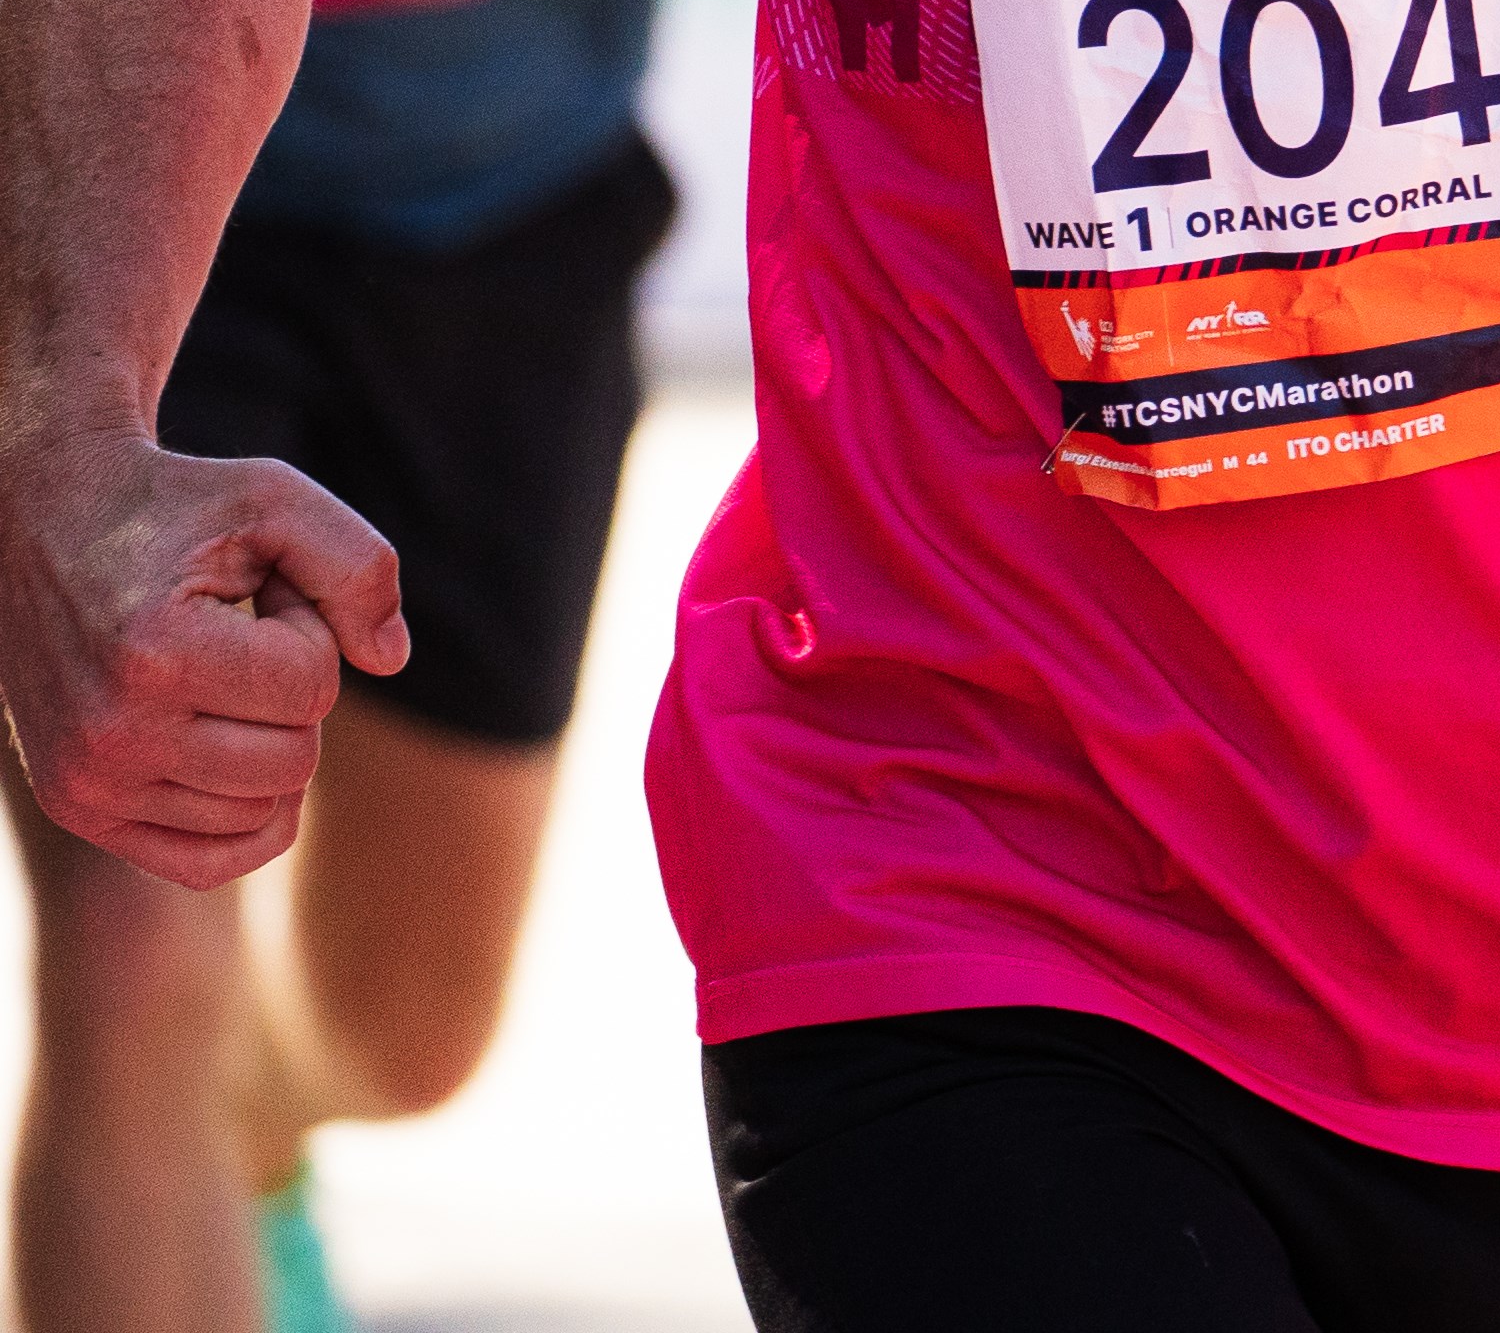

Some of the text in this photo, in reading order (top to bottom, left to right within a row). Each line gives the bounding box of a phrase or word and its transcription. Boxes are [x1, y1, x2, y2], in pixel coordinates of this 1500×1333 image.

[1023, 221, 1115, 250] WAVE
[1126, 206, 1154, 252] 1
[1186, 201, 1338, 239] ORANGE
[1347, 174, 1493, 223] CORRAL
[1101, 369, 1414, 430] #TCSNYCMarathon
[1223, 456, 1239, 470] M
[1246, 452, 1268, 466] 44
[1286, 413, 1446, 461] ITO CHARTER
